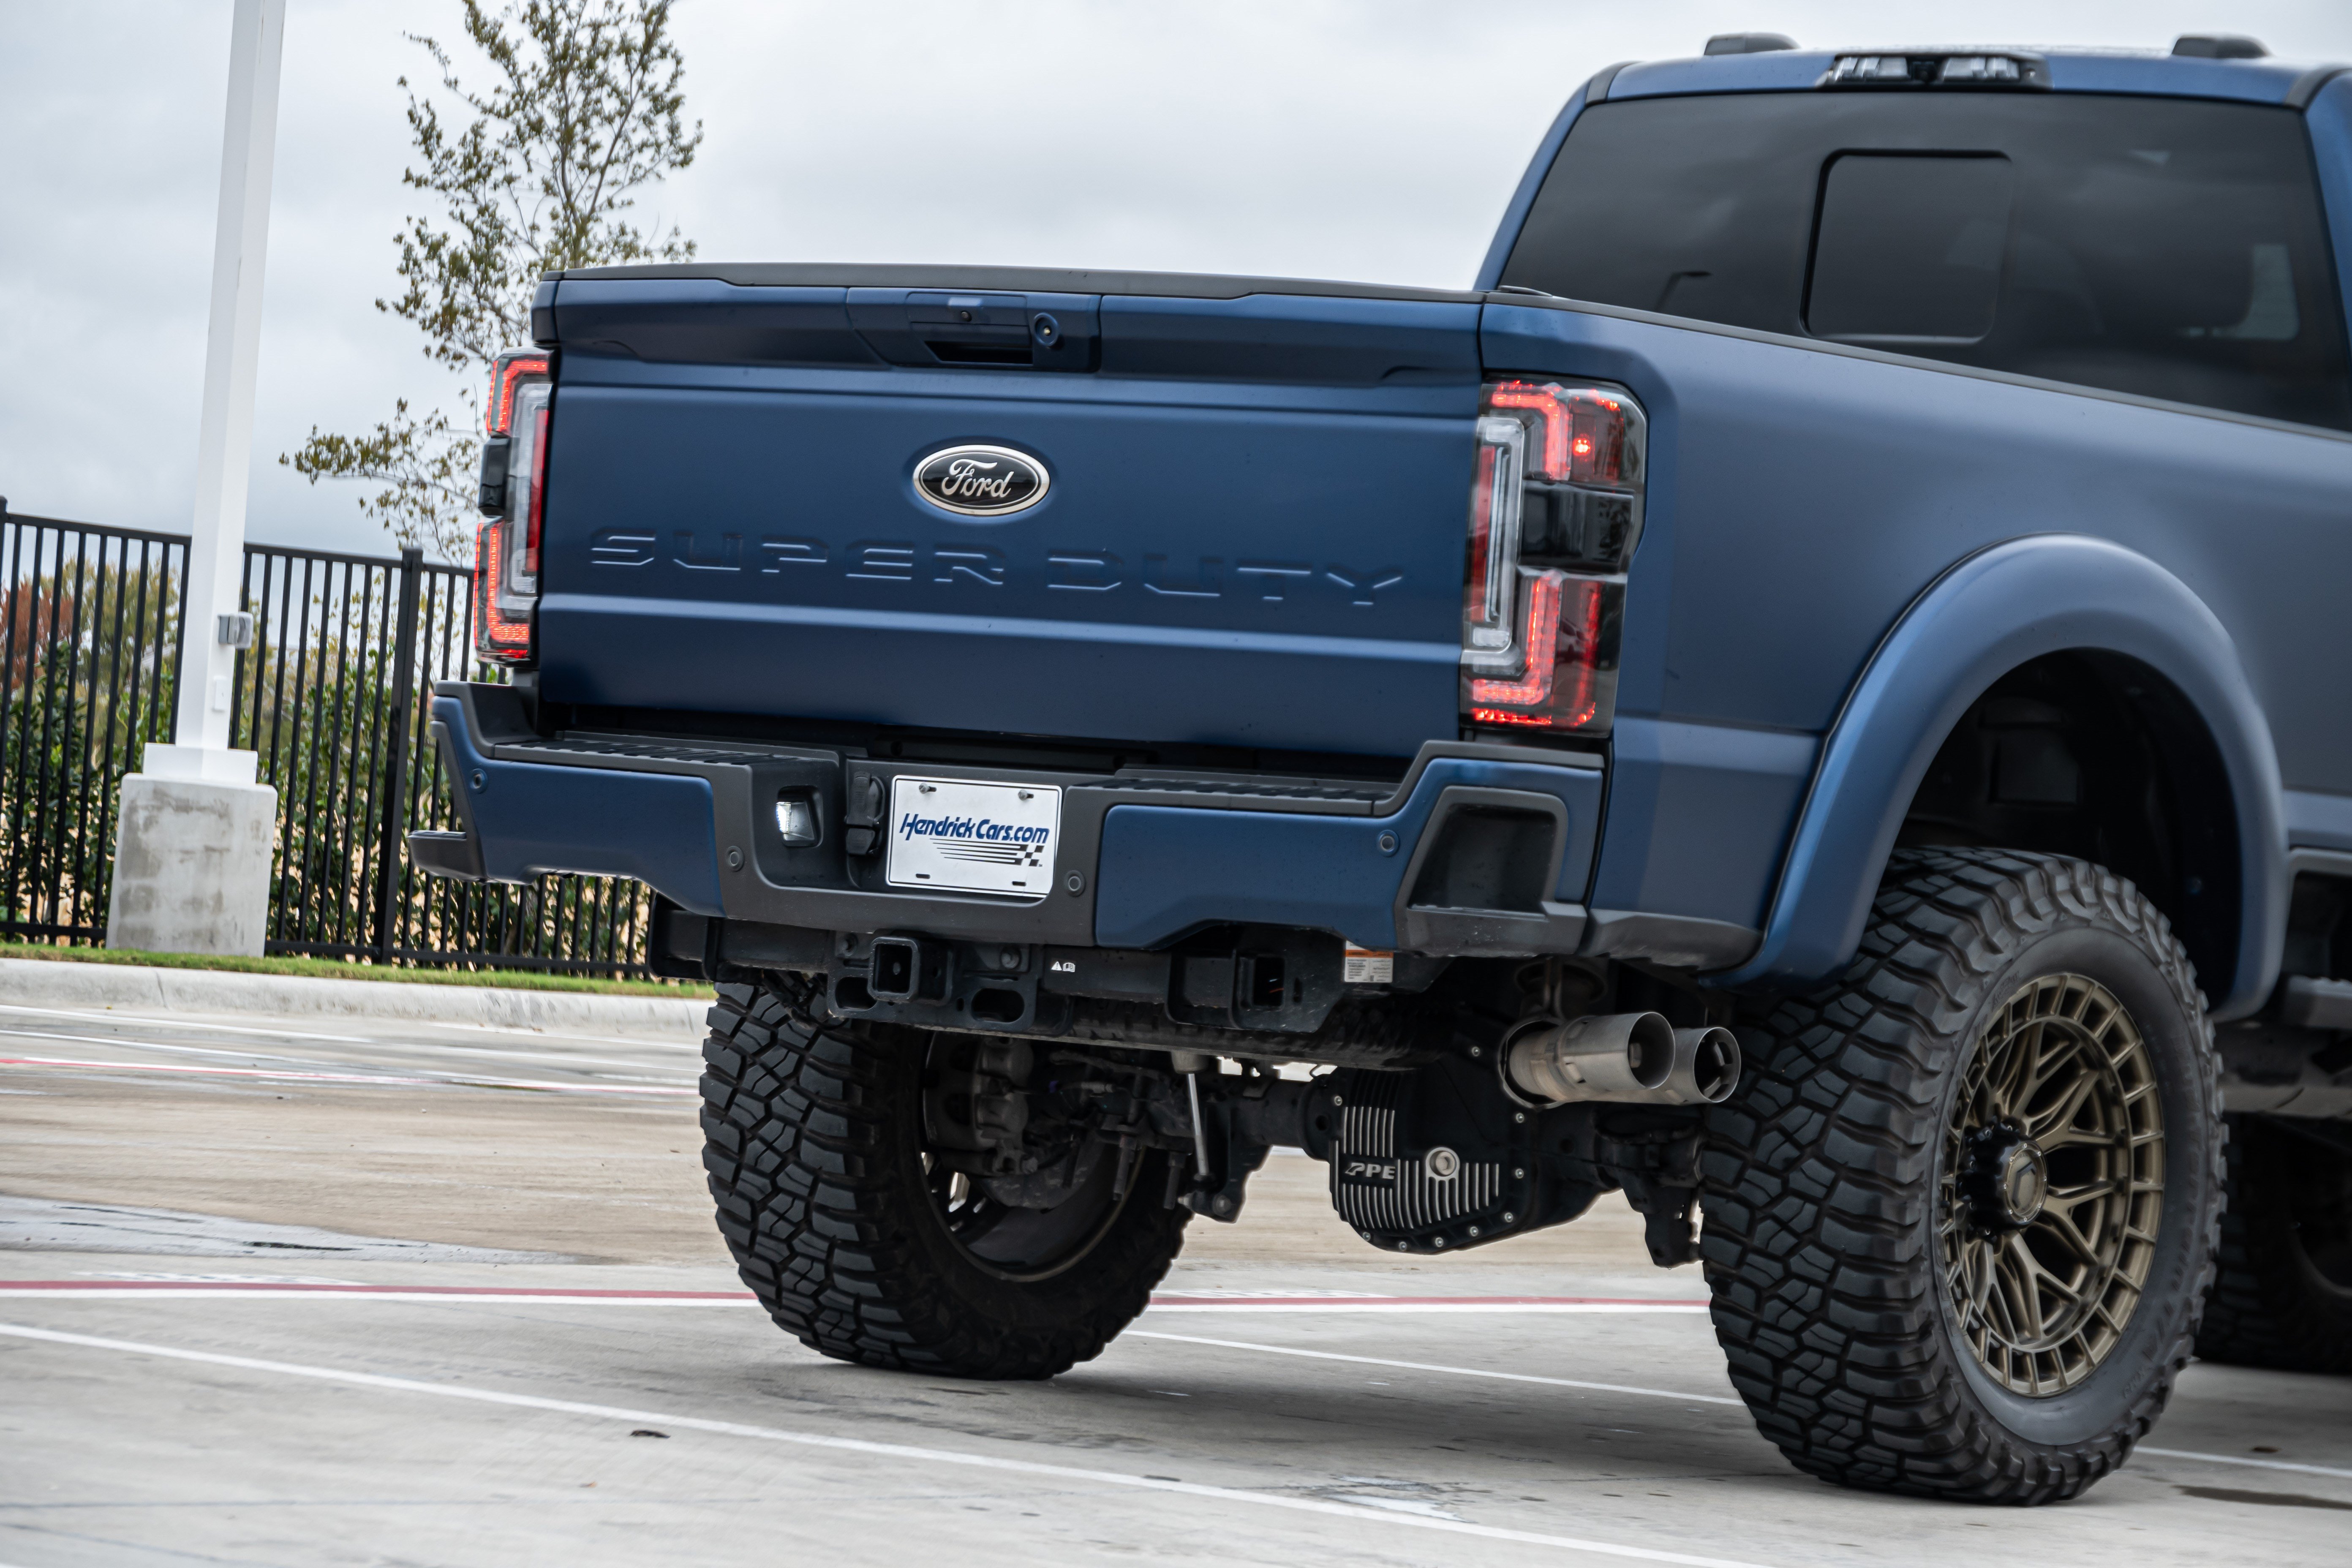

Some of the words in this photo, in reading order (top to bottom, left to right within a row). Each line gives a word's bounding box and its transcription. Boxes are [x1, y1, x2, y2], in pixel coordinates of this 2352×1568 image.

[942, 459, 1014, 497] Ford
[591, 527, 1005, 585] SUPER
[1048, 549, 1403, 605] DUTY
[1345, 1162, 1396, 1180] PPE
